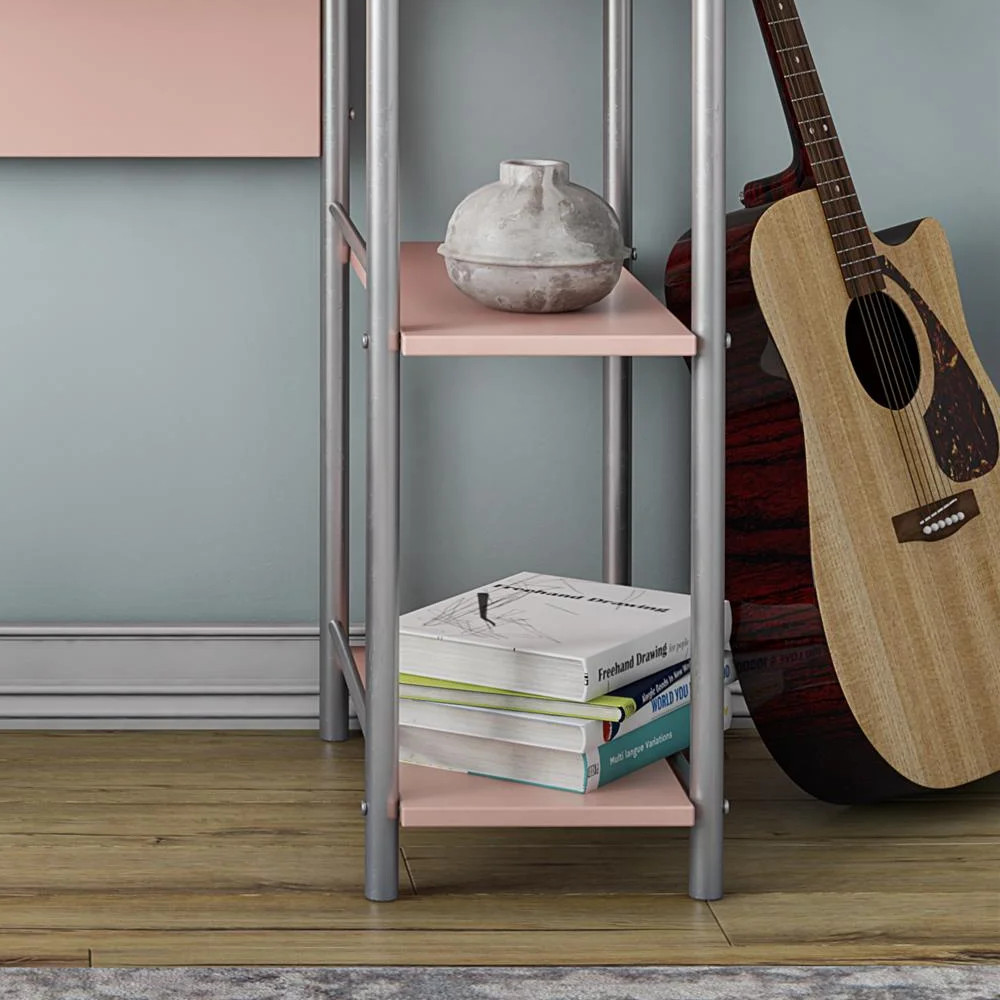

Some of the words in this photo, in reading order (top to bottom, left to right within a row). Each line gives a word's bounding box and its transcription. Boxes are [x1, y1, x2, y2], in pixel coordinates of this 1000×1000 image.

[493, 584, 584, 600] Freehand
[587, 597, 671, 613] Drawing
[598, 655, 635, 682] Freehand
[636, 642, 668, 667] Drawing
[651, 692, 675, 713] WORLD
[674, 683, 689, 702] YOU
[609, 751, 624, 766] Multi
[624, 744, 645, 759] langue
[645, 731, 673, 749] Variations
